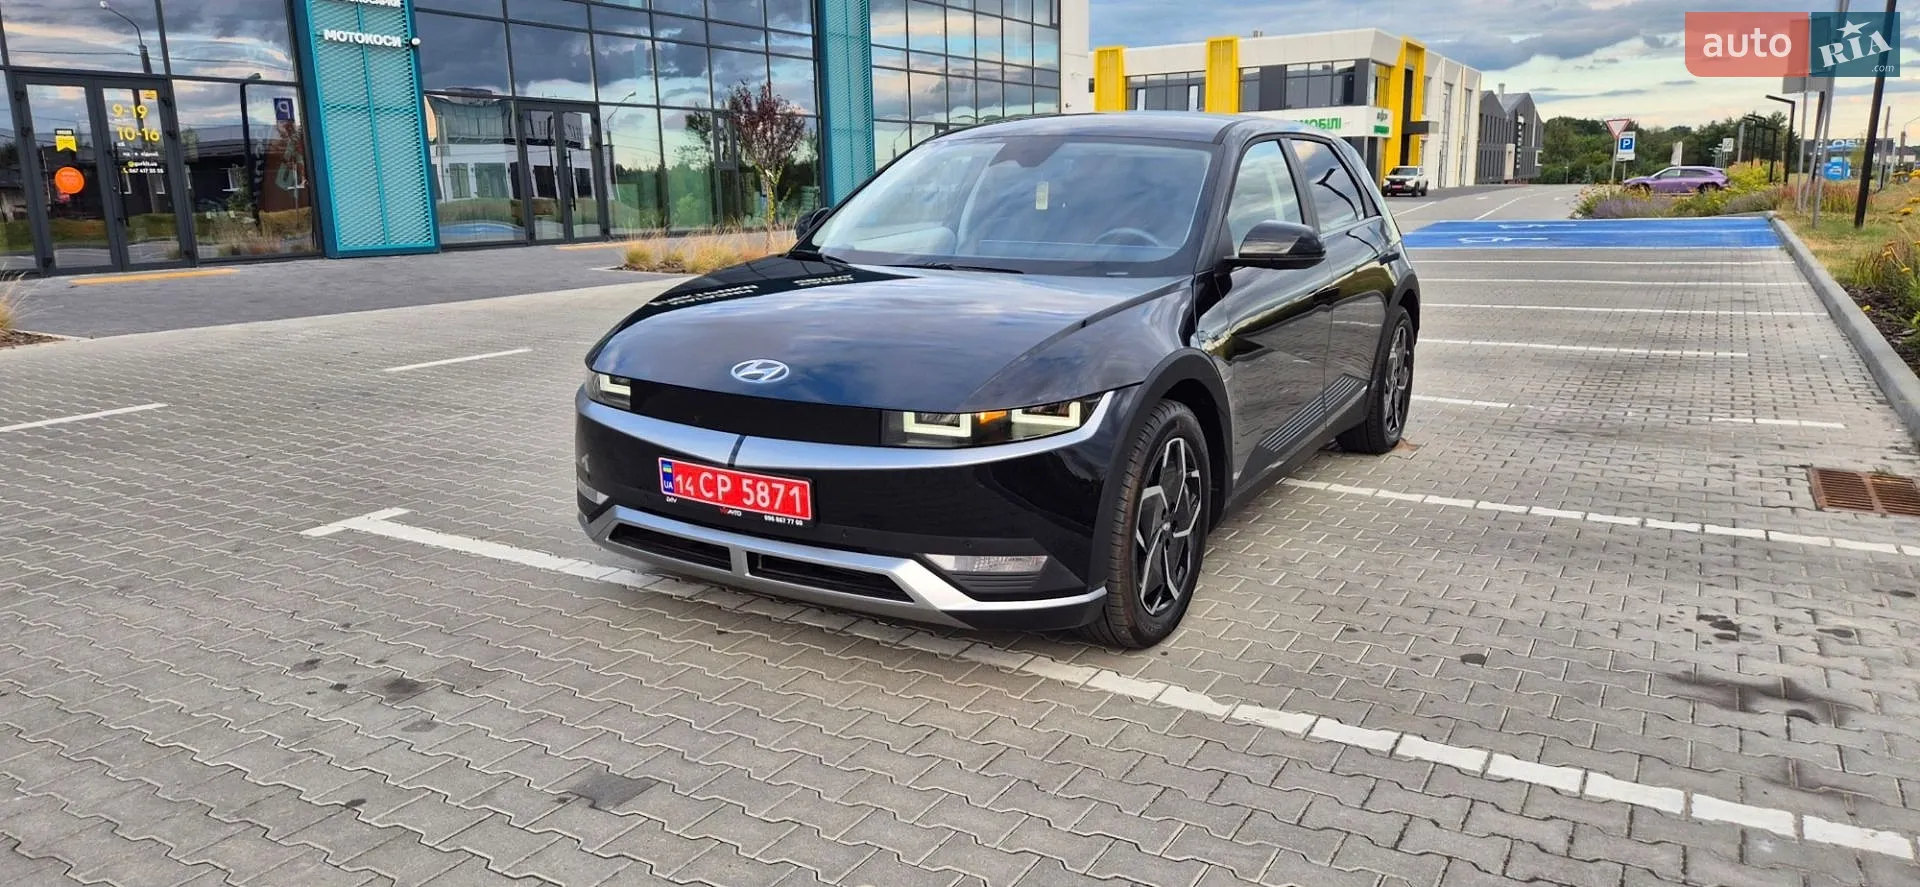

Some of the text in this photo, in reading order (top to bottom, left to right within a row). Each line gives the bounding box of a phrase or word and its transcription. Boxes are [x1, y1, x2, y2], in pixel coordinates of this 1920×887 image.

[323, 29, 402, 47] МОТОКОСИ
[112, 103, 148, 118] 9-19
[117, 127, 160, 141] 10-16
[1622, 138, 1631, 149] P
[663, 472, 801, 513] UA 14 CP 5871
